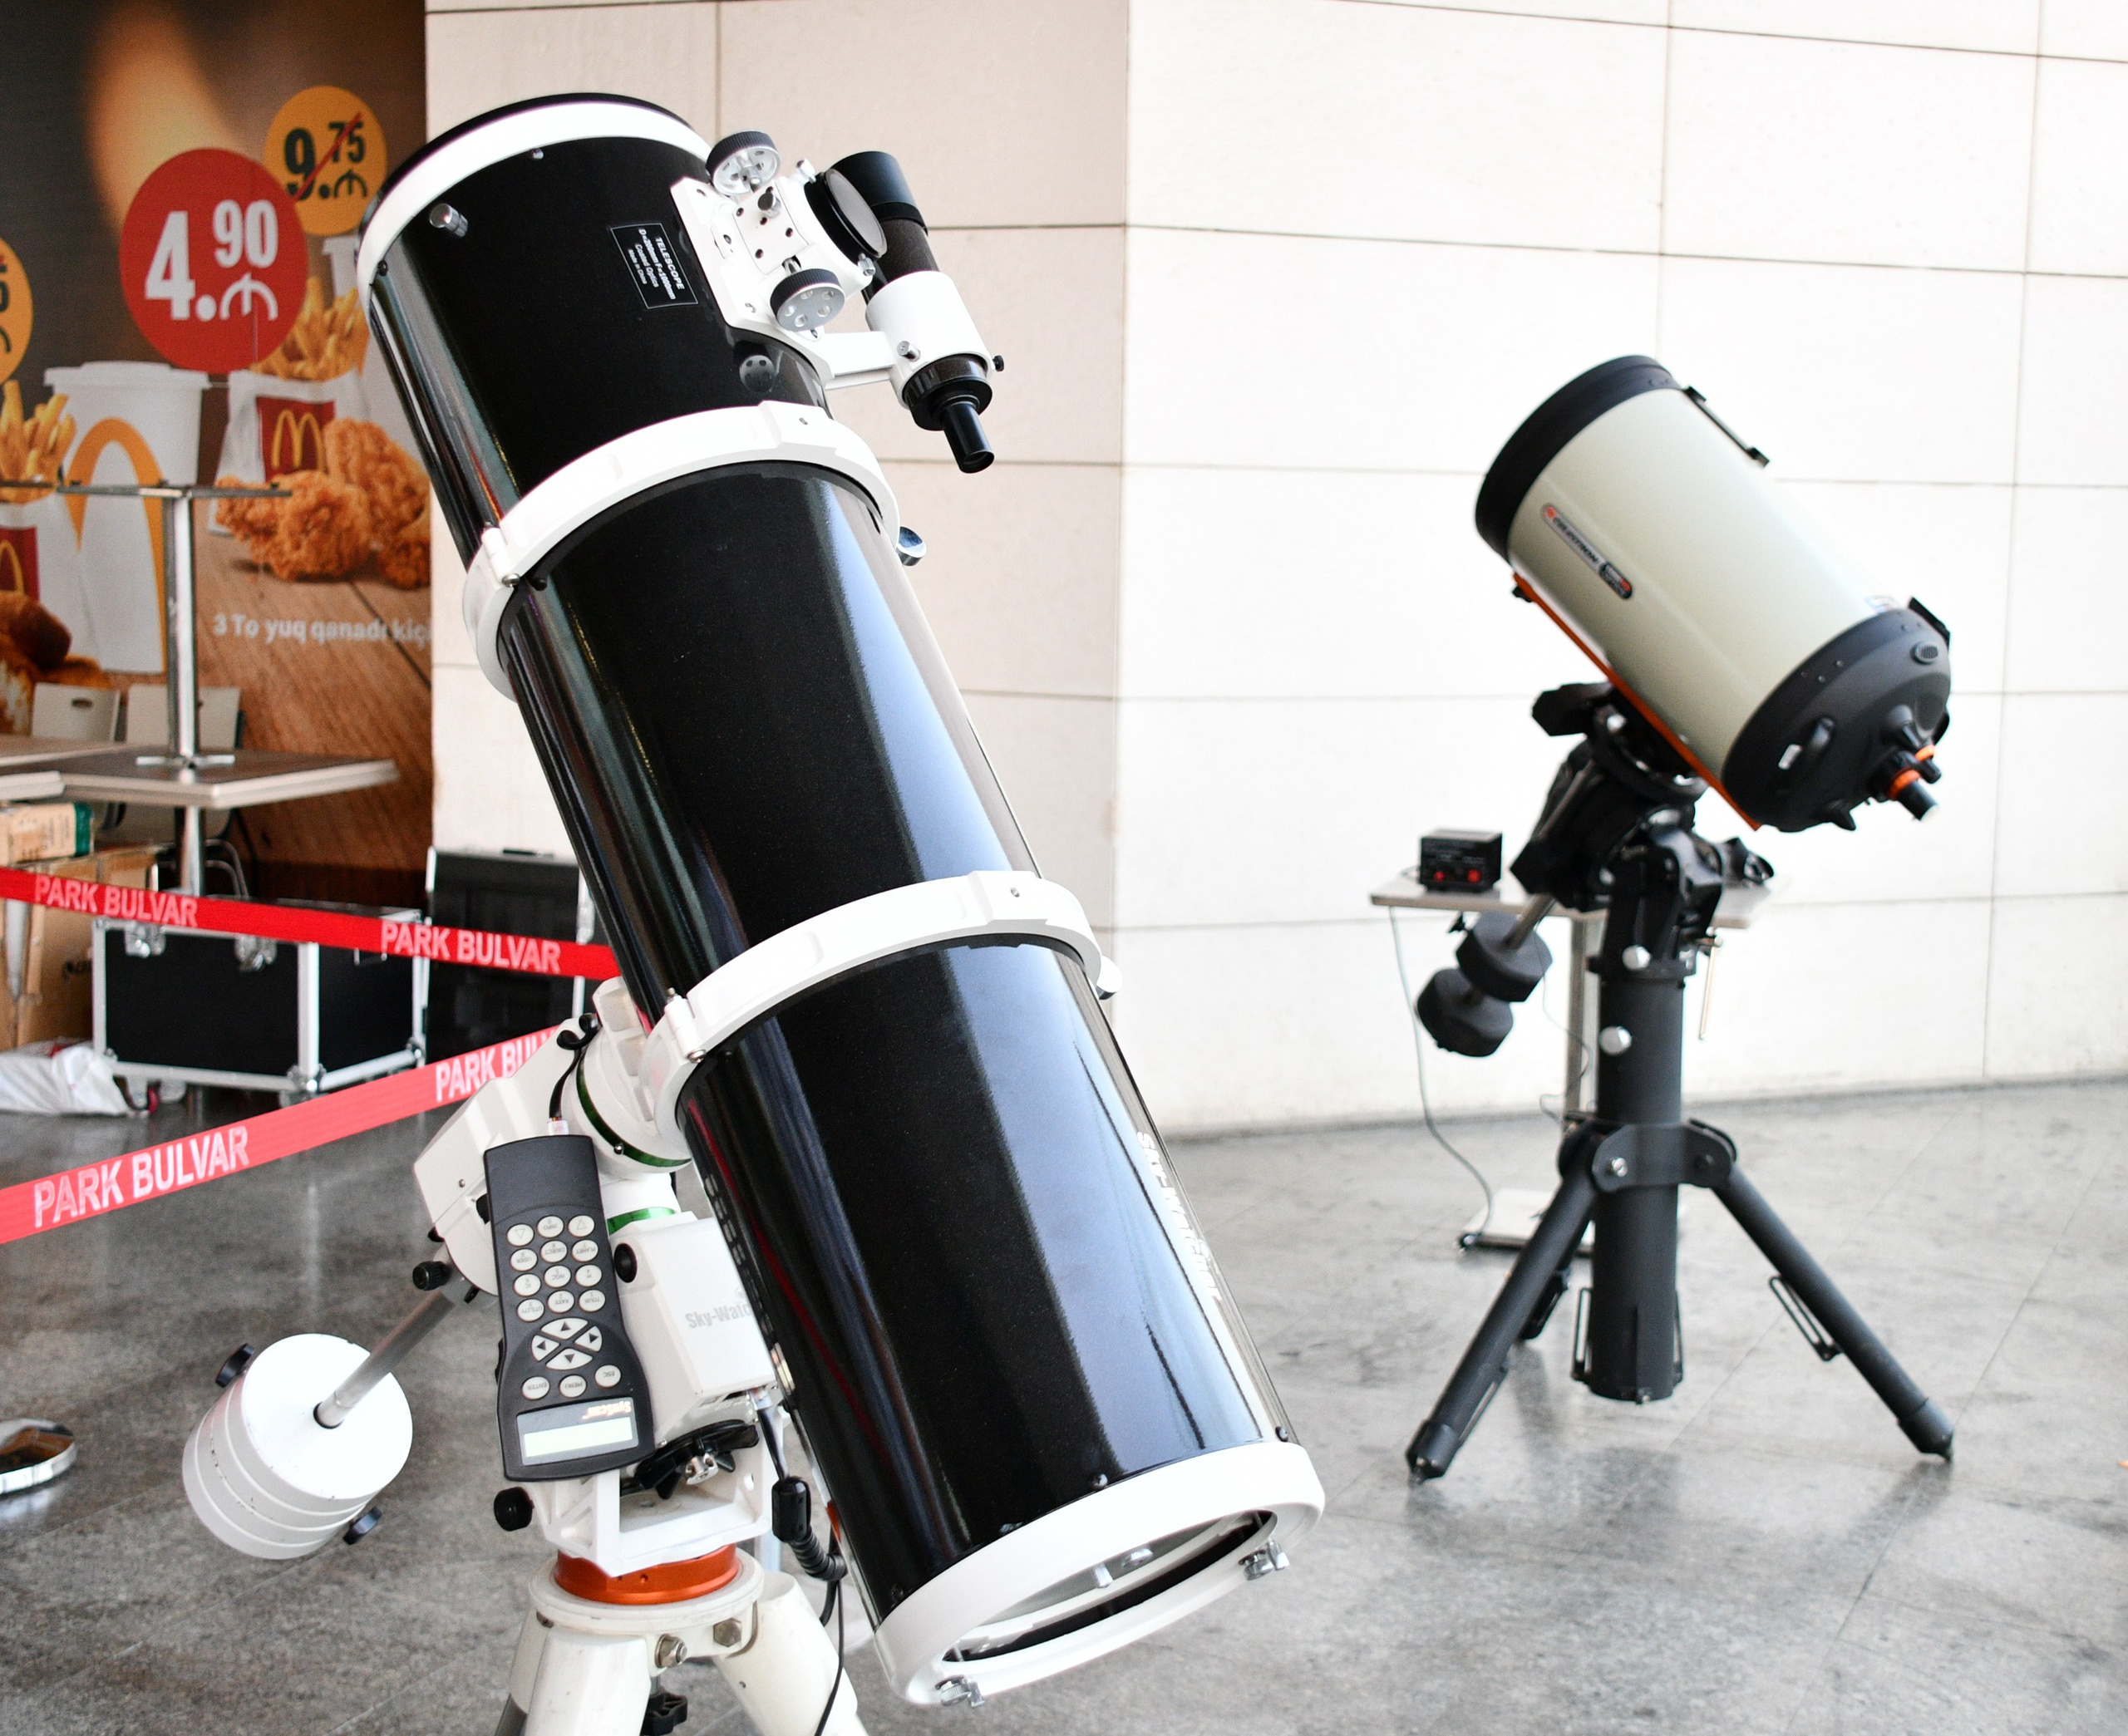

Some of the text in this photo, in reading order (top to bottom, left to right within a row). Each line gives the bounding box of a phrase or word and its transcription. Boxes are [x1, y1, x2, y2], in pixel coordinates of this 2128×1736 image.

[628, 249, 638, 263] Made
[637, 268, 648, 284] China
[634, 243, 659, 288] Coated Optics
[655, 237, 685, 290] TELESCOPE
[214, 613, 227, 637] 3
[264, 619, 307, 646] yuq
[35, 875, 199, 927] PARK BULVAR
[382, 922, 561, 974] PARK BULVAR
[436, 1047, 496, 1103] PARK
[34, 1125, 249, 1228] PARK BULVAR
[527, 1381, 547, 1390] ENTER
